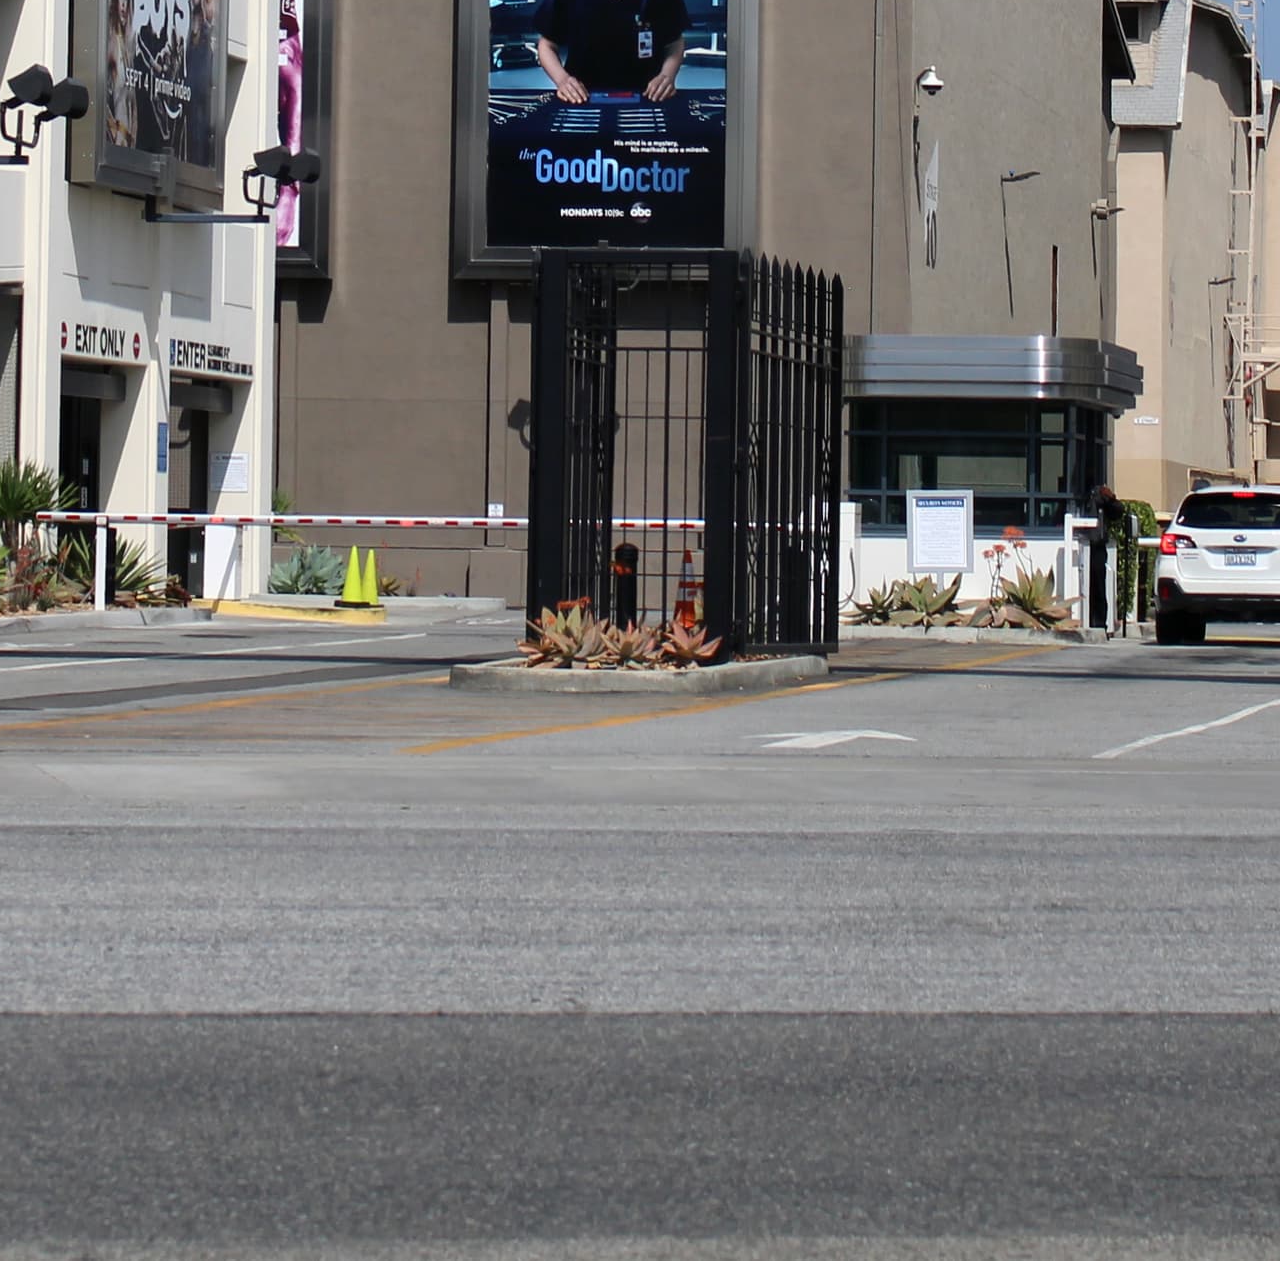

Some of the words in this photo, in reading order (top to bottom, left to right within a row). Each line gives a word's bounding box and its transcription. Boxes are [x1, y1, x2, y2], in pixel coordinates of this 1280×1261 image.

[125, 67, 142, 90] SEPT
[144, 73, 149, 92] 4
[519, 148, 537, 161] the
[535, 148, 602, 184] Good
[601, 158, 691, 192] Doctor
[560, 208, 604, 218] MONDAYS
[630, 207, 652, 218] abc
[75, 323, 98, 355] EXIT
[100, 326, 126, 358] ONLY
[177, 339, 206, 371] ENTER
